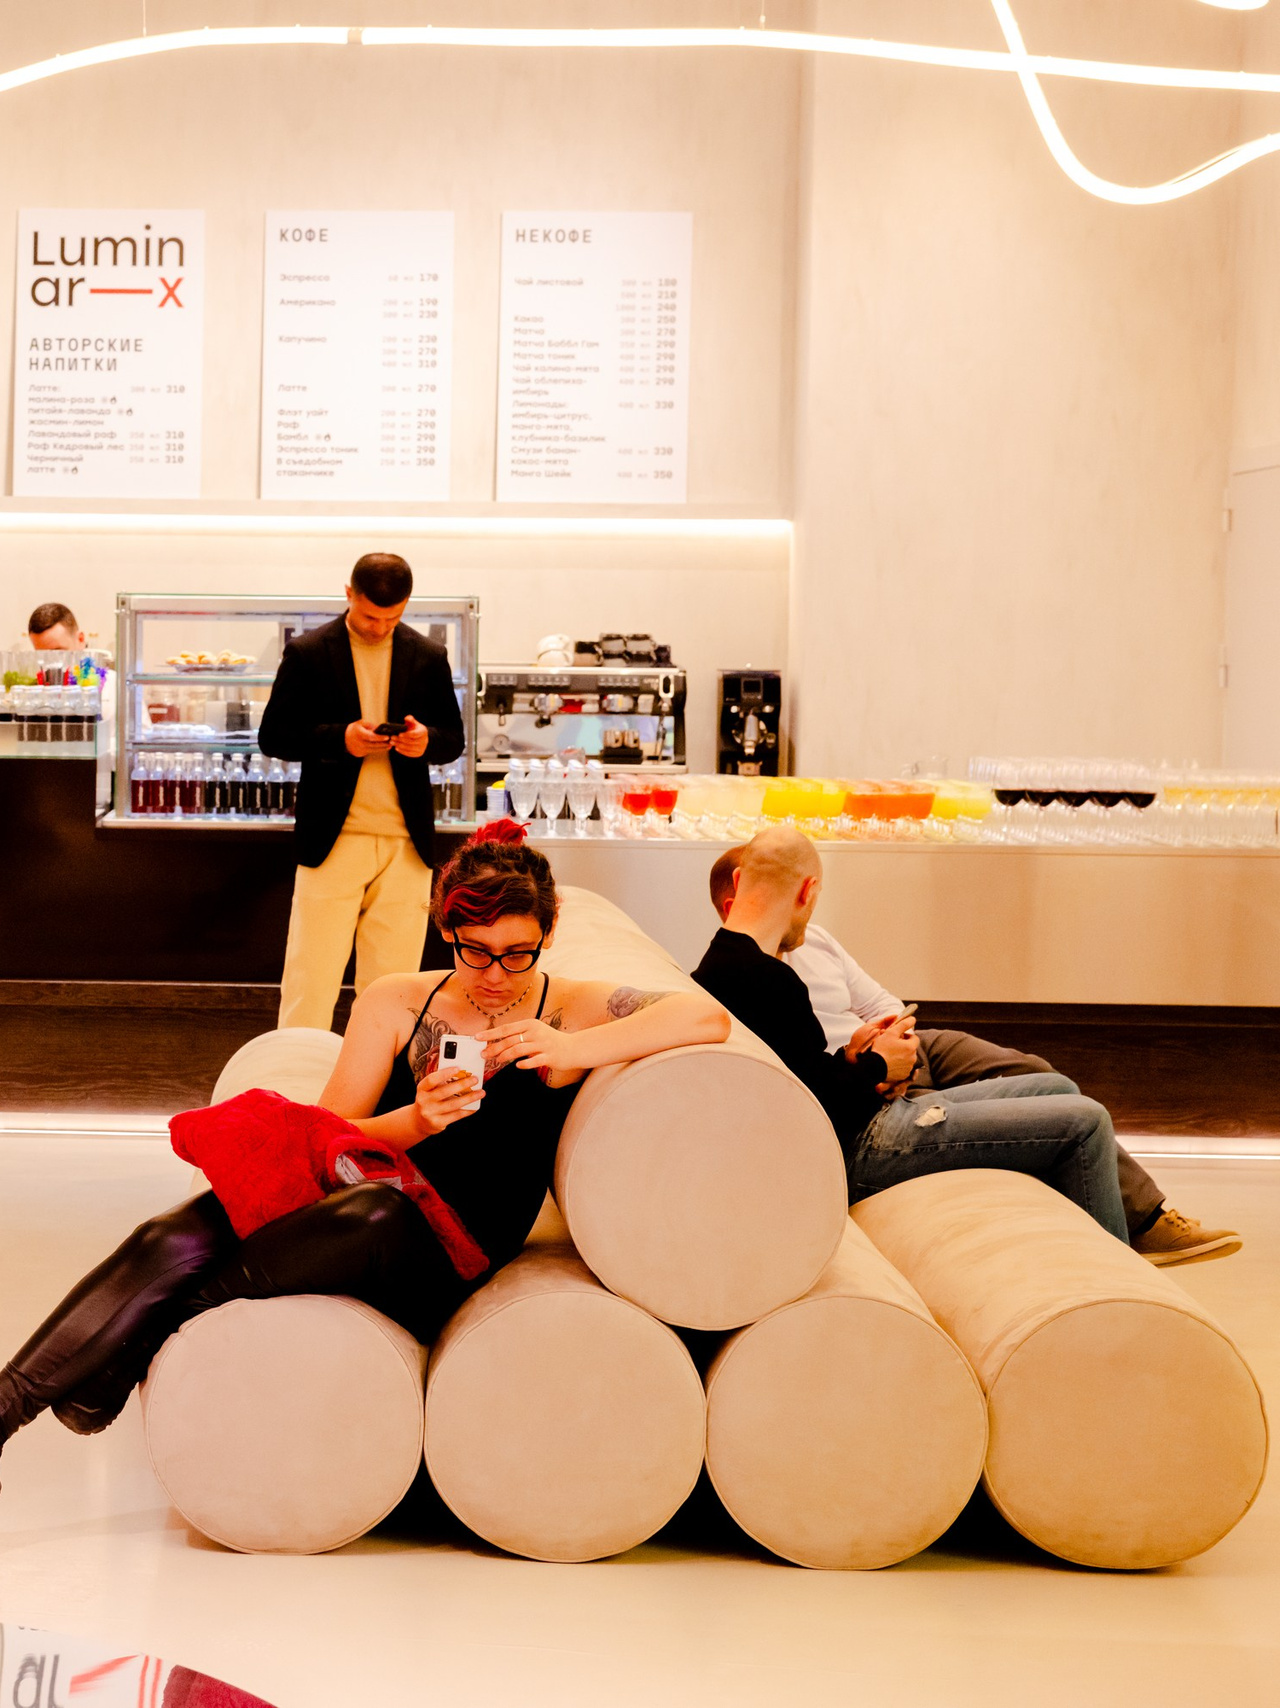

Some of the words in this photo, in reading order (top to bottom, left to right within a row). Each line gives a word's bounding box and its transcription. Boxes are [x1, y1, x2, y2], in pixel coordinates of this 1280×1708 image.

[279, 228, 328, 243] КОФЕ
[515, 228, 592, 244] НЕКОФЕ
[33, 224, 184, 267] Lumin
[280, 273, 330, 283] Эспрессо
[420, 273, 439, 282] 170
[514, 277, 534, 286] Чай
[658, 278, 678, 287] 180
[657, 290, 677, 300] 210
[279, 298, 336, 307] Американо
[419, 298, 439, 307] 190
[657, 303, 677, 312] 240
[419, 310, 438, 319] 230
[513, 315, 544, 323] Какао
[657, 315, 676, 324] 250
[513, 327, 546, 336] Матча
[656, 328, 676, 337] 270
[29, 337, 143, 352] АВТОРСКИЕ
[418, 335, 438, 344] 230
[513, 339, 545, 348] Матча
[656, 340, 676, 349] 290
[418, 347, 438, 356] 270
[513, 352, 545, 360] Матча
[656, 352, 676, 361] 290
[29, 357, 117, 371] НАПИТКИ
[418, 359, 437, 368] 310
[513, 364, 532, 372] Чай
[655, 364, 675, 374] 290
[512, 376, 532, 384] Чай
[655, 377, 675, 386] 290
[166, 385, 186, 394] 310
[278, 384, 308, 392] Латте
[417, 384, 437, 393] 270
[655, 400, 674, 409] 330
[416, 408, 436, 417] 270
[277, 421, 300, 430] Раф
[417, 421, 436, 430] 290
[165, 430, 185, 440] 310
[276, 433, 309, 441] Бамбл
[416, 433, 436, 442] 290
[27, 442, 50, 451] Раф
[165, 443, 185, 452] 310
[277, 445, 328, 454] Эспрессо
[416, 445, 436, 454] 290
[654, 446, 673, 456] 330
[165, 455, 185, 464] 310
[276, 457, 283, 465] В
[285, 457, 343, 467] съедобном
[416, 457, 436, 467] 350
[510, 469, 543, 478] Манго
[544, 469, 572, 478] Шейк
[653, 470, 673, 479] 350
